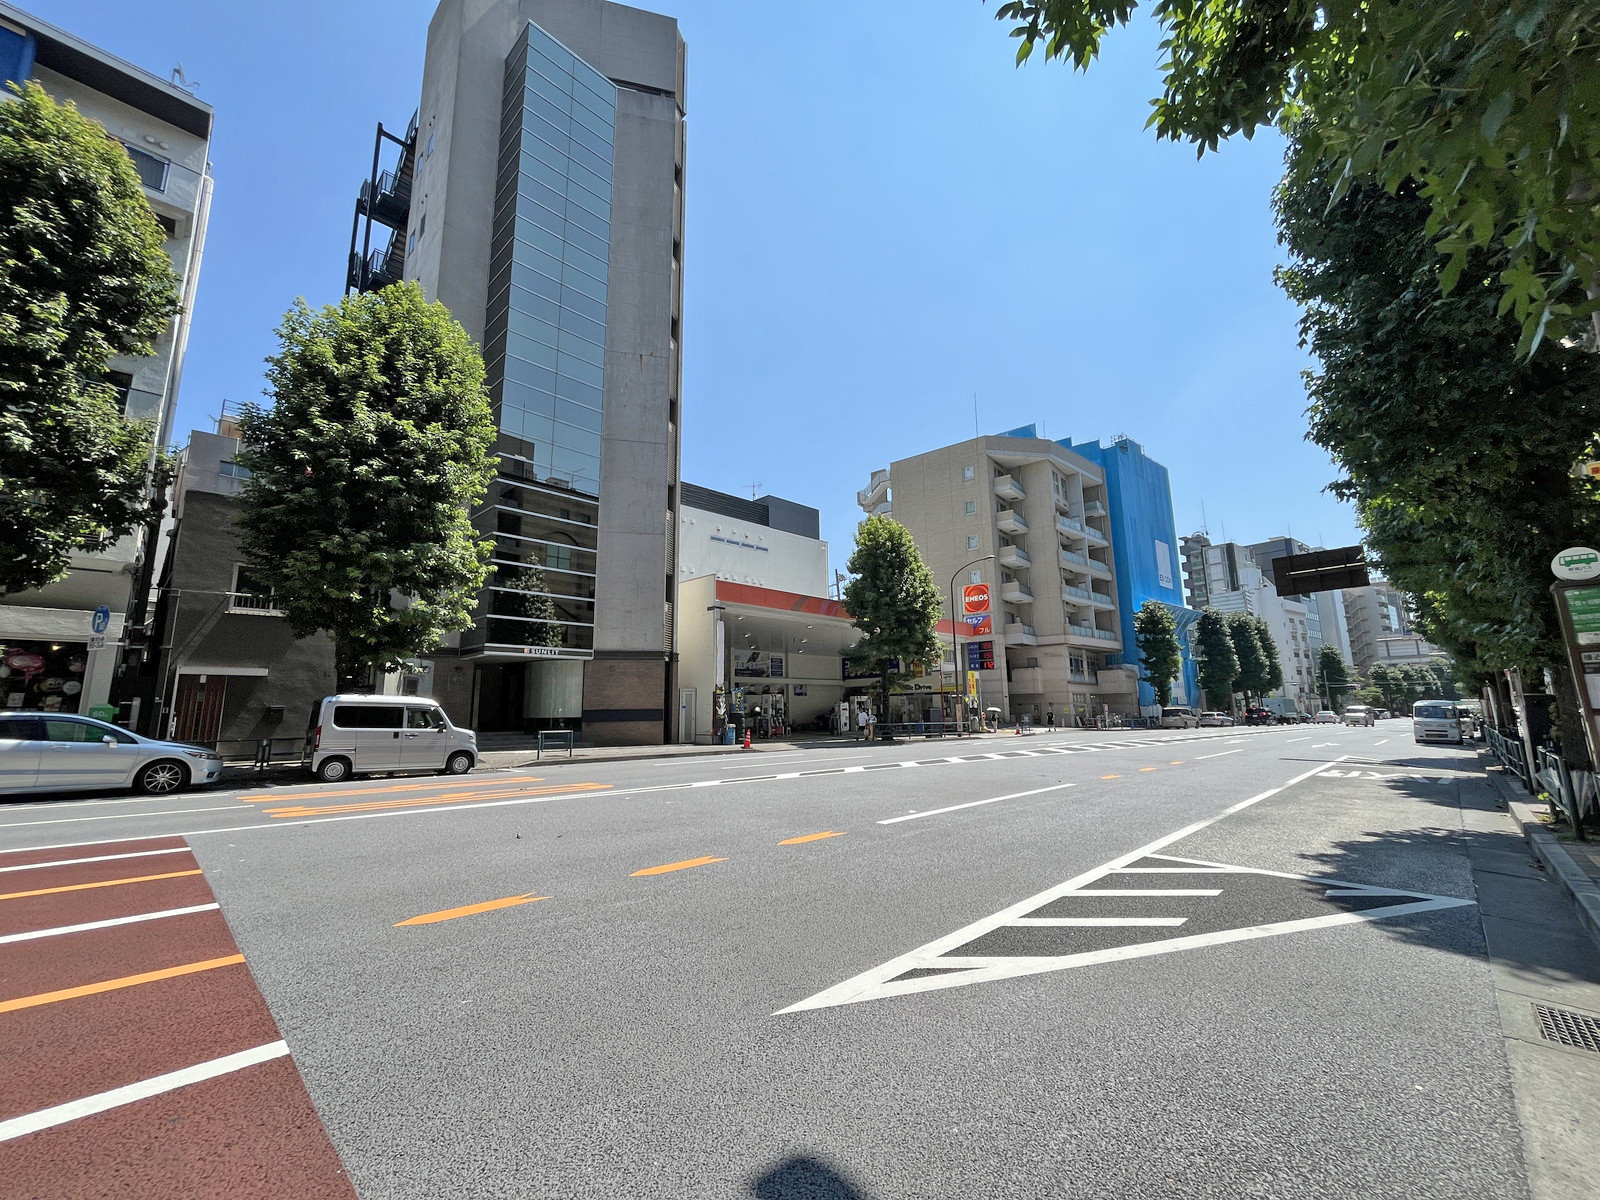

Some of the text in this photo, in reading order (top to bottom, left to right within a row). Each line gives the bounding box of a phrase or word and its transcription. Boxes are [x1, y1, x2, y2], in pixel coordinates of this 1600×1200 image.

[965, 594, 988, 602] ENEOS
[94, 613, 104, 630] P
[966, 617, 983, 625] セルフ
[978, 626, 991, 634] フル
[914, 683, 932, 691] Drive
